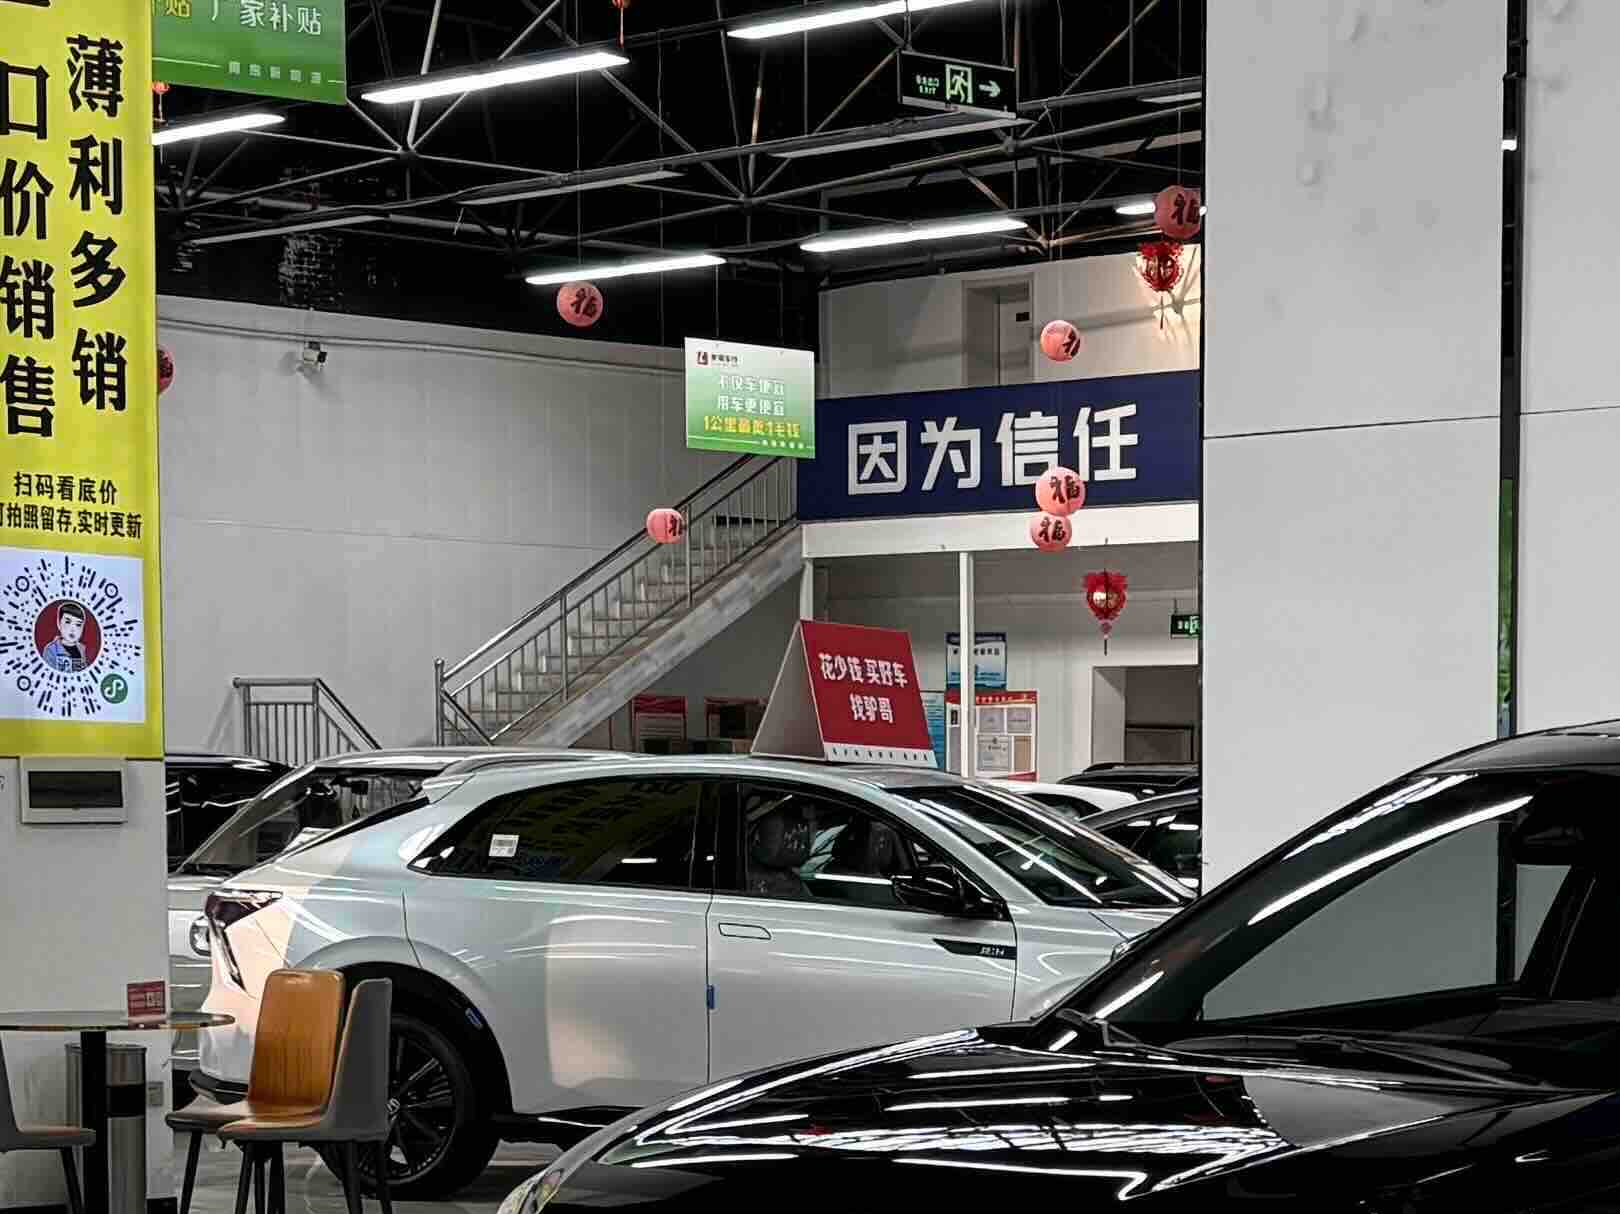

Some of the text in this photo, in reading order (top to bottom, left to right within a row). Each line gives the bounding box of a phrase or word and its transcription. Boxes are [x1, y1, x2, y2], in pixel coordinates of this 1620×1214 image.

[66, 33, 128, 412] 薄利多销
[847, 403, 1139, 495] 因为信任
[14, 471, 118, 505] 扫码看底价
[1049, 474, 1081, 505] 福
